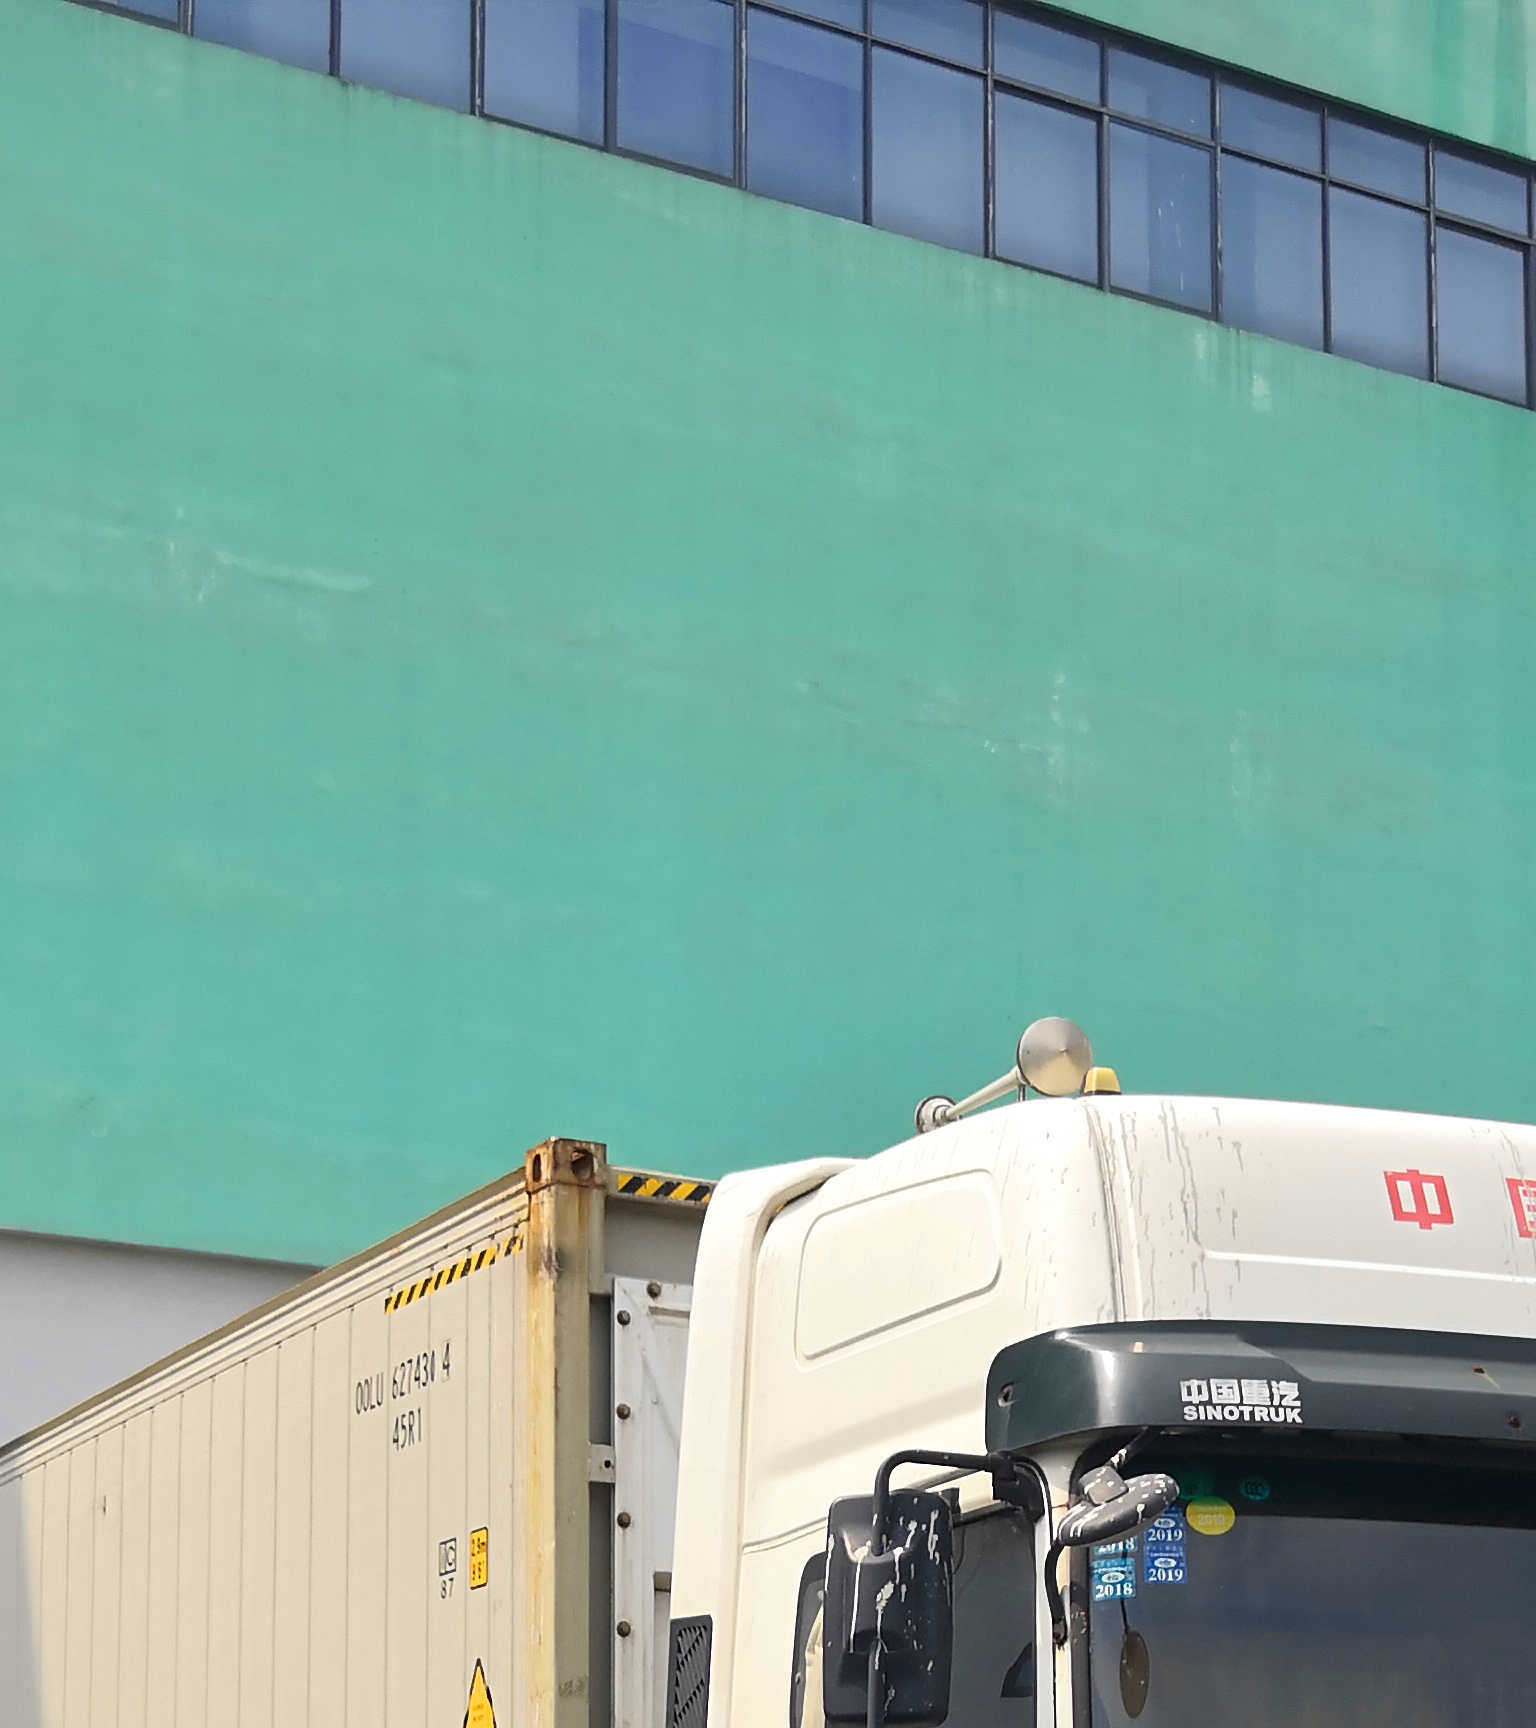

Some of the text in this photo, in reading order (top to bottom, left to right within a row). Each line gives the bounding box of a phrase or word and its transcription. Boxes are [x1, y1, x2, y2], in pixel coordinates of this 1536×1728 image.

[355, 1371, 384, 1415] OOLU
[1180, 1378, 1302, 1407] 中国重汽
[1183, 1405, 1303, 1423] SINOTRUK
[392, 1407, 422, 1451] 45R1
[1148, 1528, 1183, 1541] 2019
[1148, 1568, 1183, 1581] 2019
[1096, 1582, 1133, 1598] 2018
